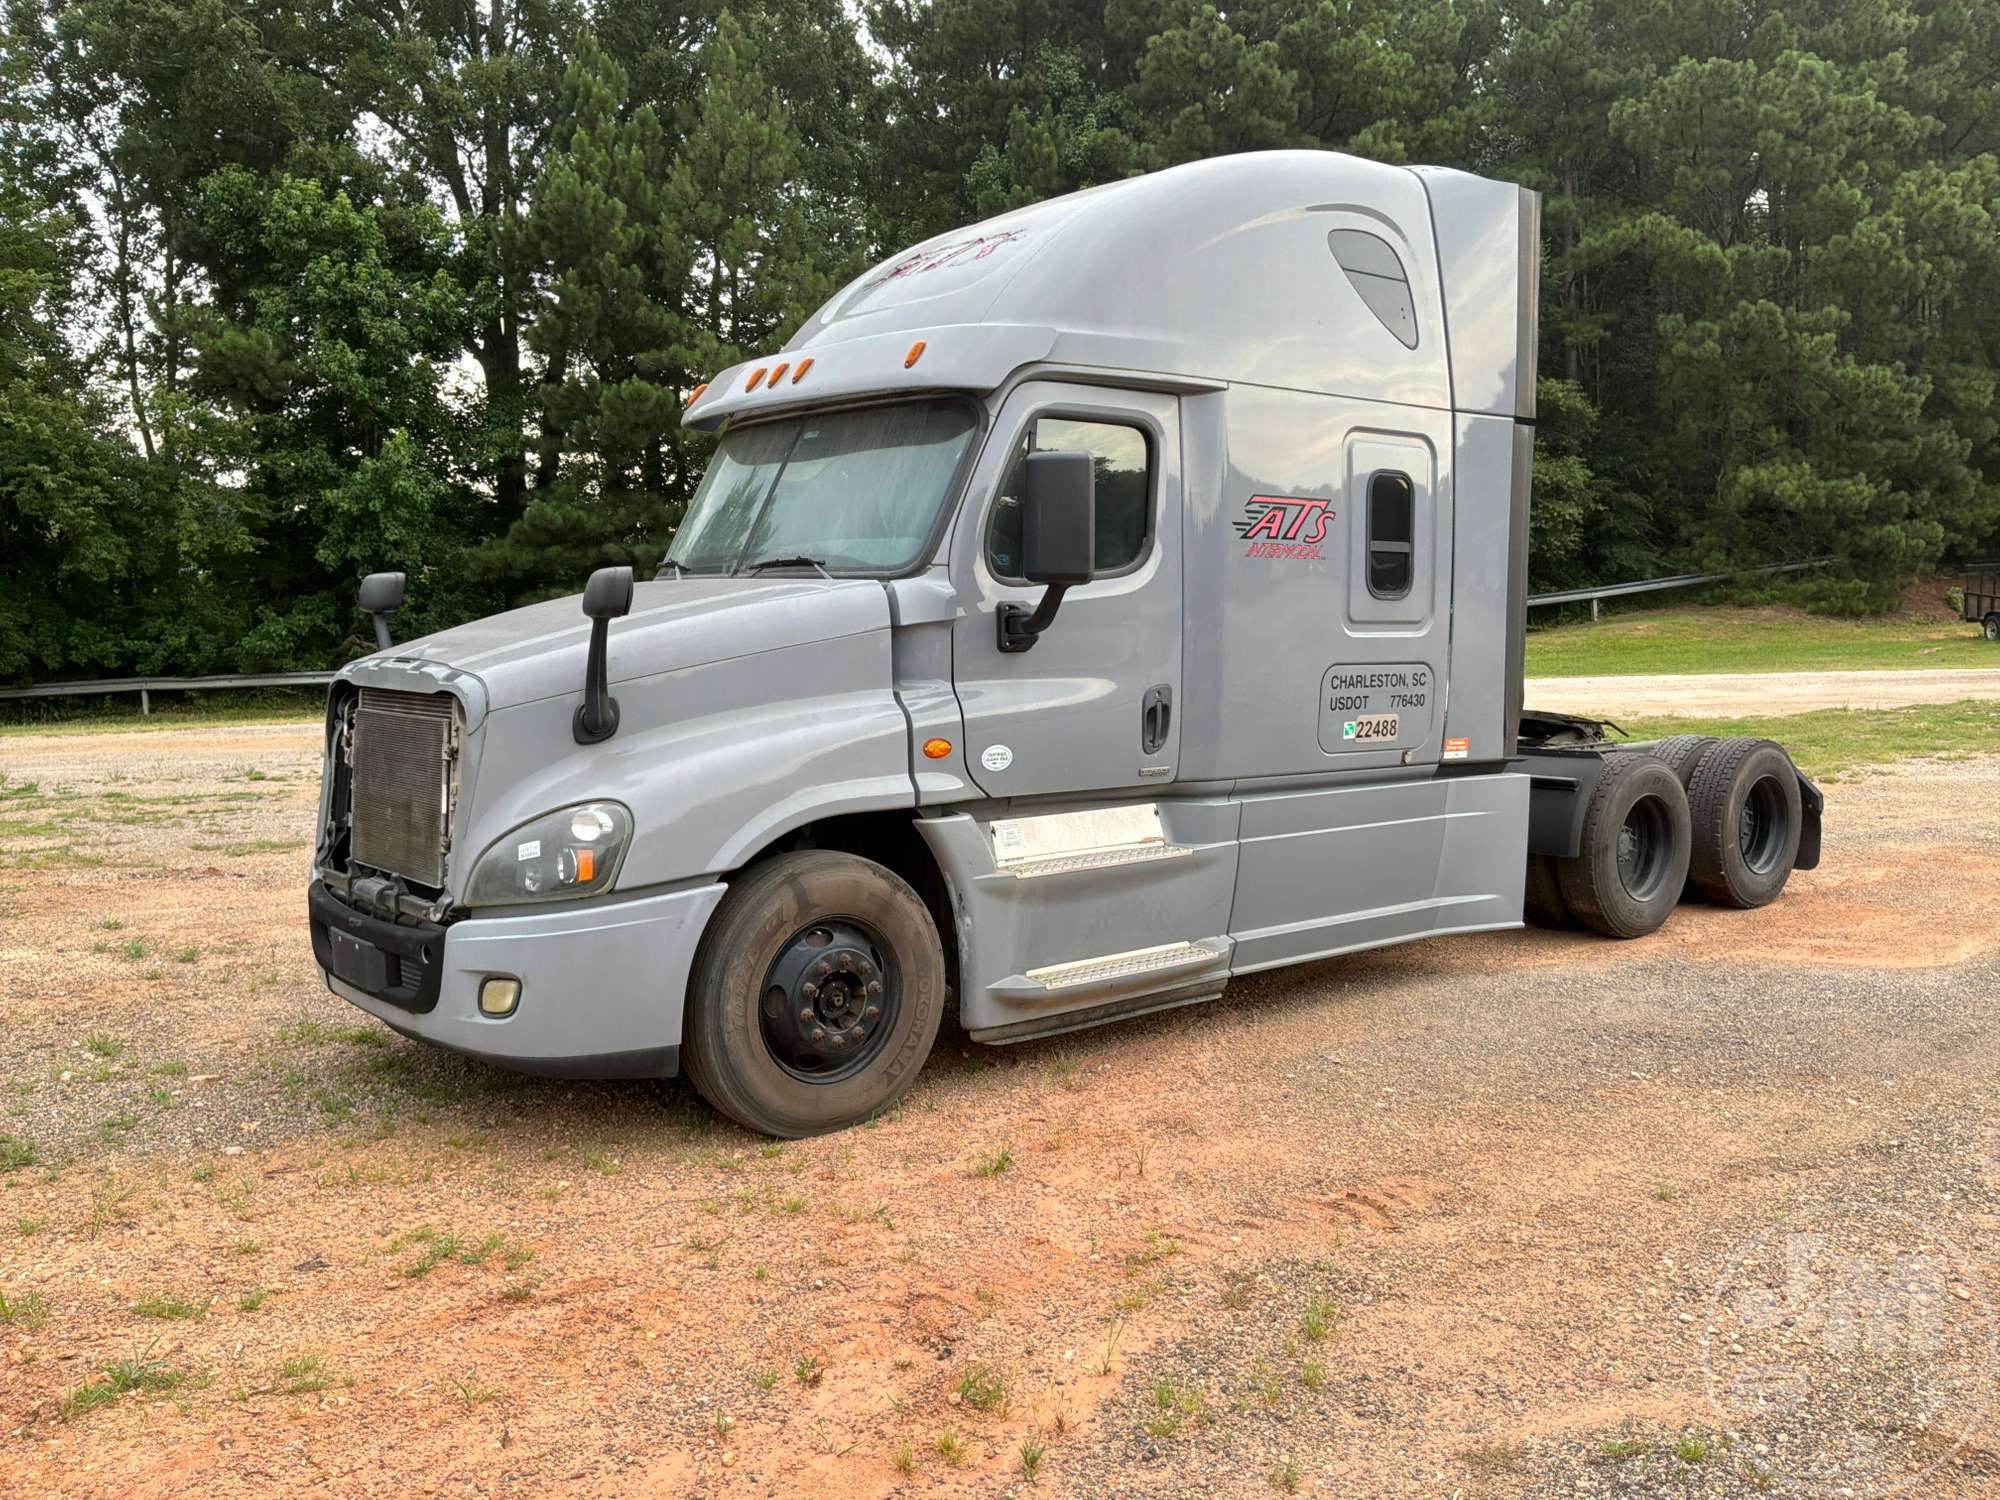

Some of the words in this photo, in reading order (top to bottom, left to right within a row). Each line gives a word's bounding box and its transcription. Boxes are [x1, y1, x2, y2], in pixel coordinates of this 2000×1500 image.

[1331, 673, 1409, 689] CHARLESTON,
[1412, 672, 1427, 687] SC
[1330, 695, 1369, 711] USDOT
[1390, 693, 1425, 708] 776430
[1356, 719, 1397, 738] 22488
